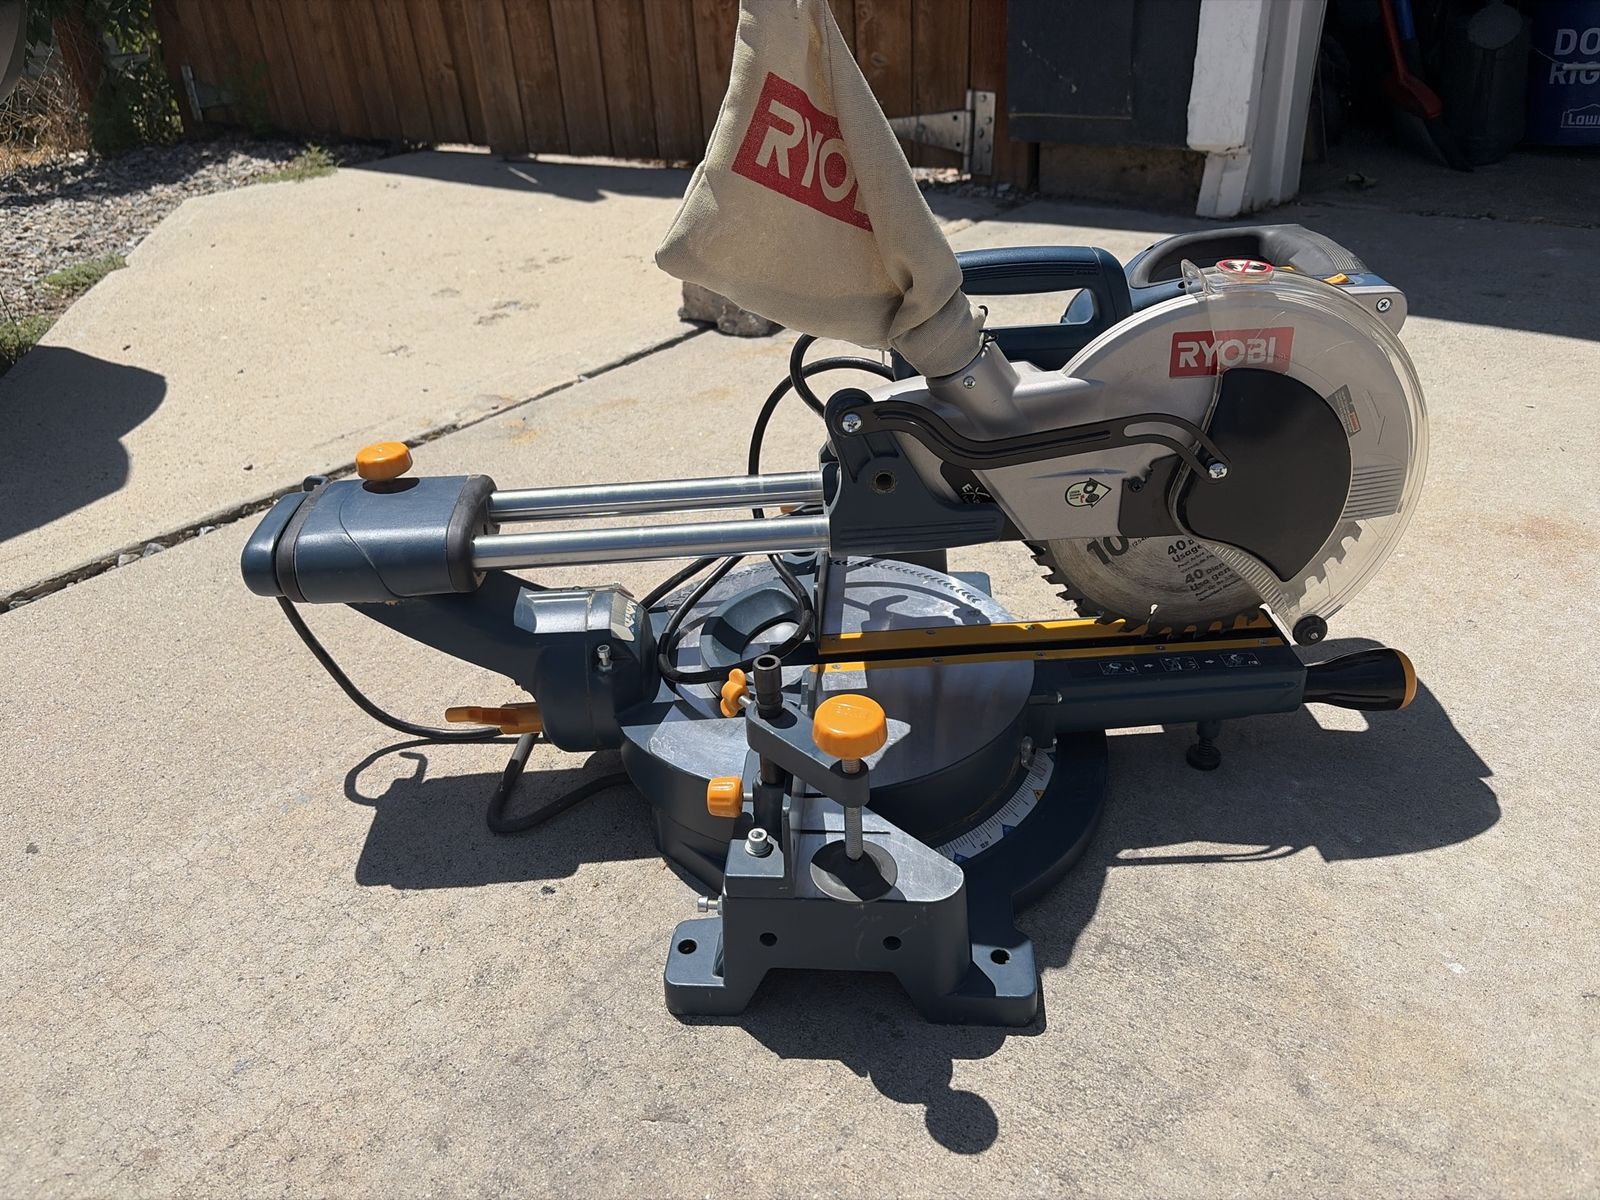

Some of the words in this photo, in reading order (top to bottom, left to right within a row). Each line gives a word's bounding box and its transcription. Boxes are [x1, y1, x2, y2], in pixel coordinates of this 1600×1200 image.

[755, 99, 858, 203] RYO
[1178, 337, 1276, 368] RYOBI
[1087, 537, 1129, 565] 10
[1168, 540, 1186, 555] 40
[1185, 569, 1204, 584] 40
